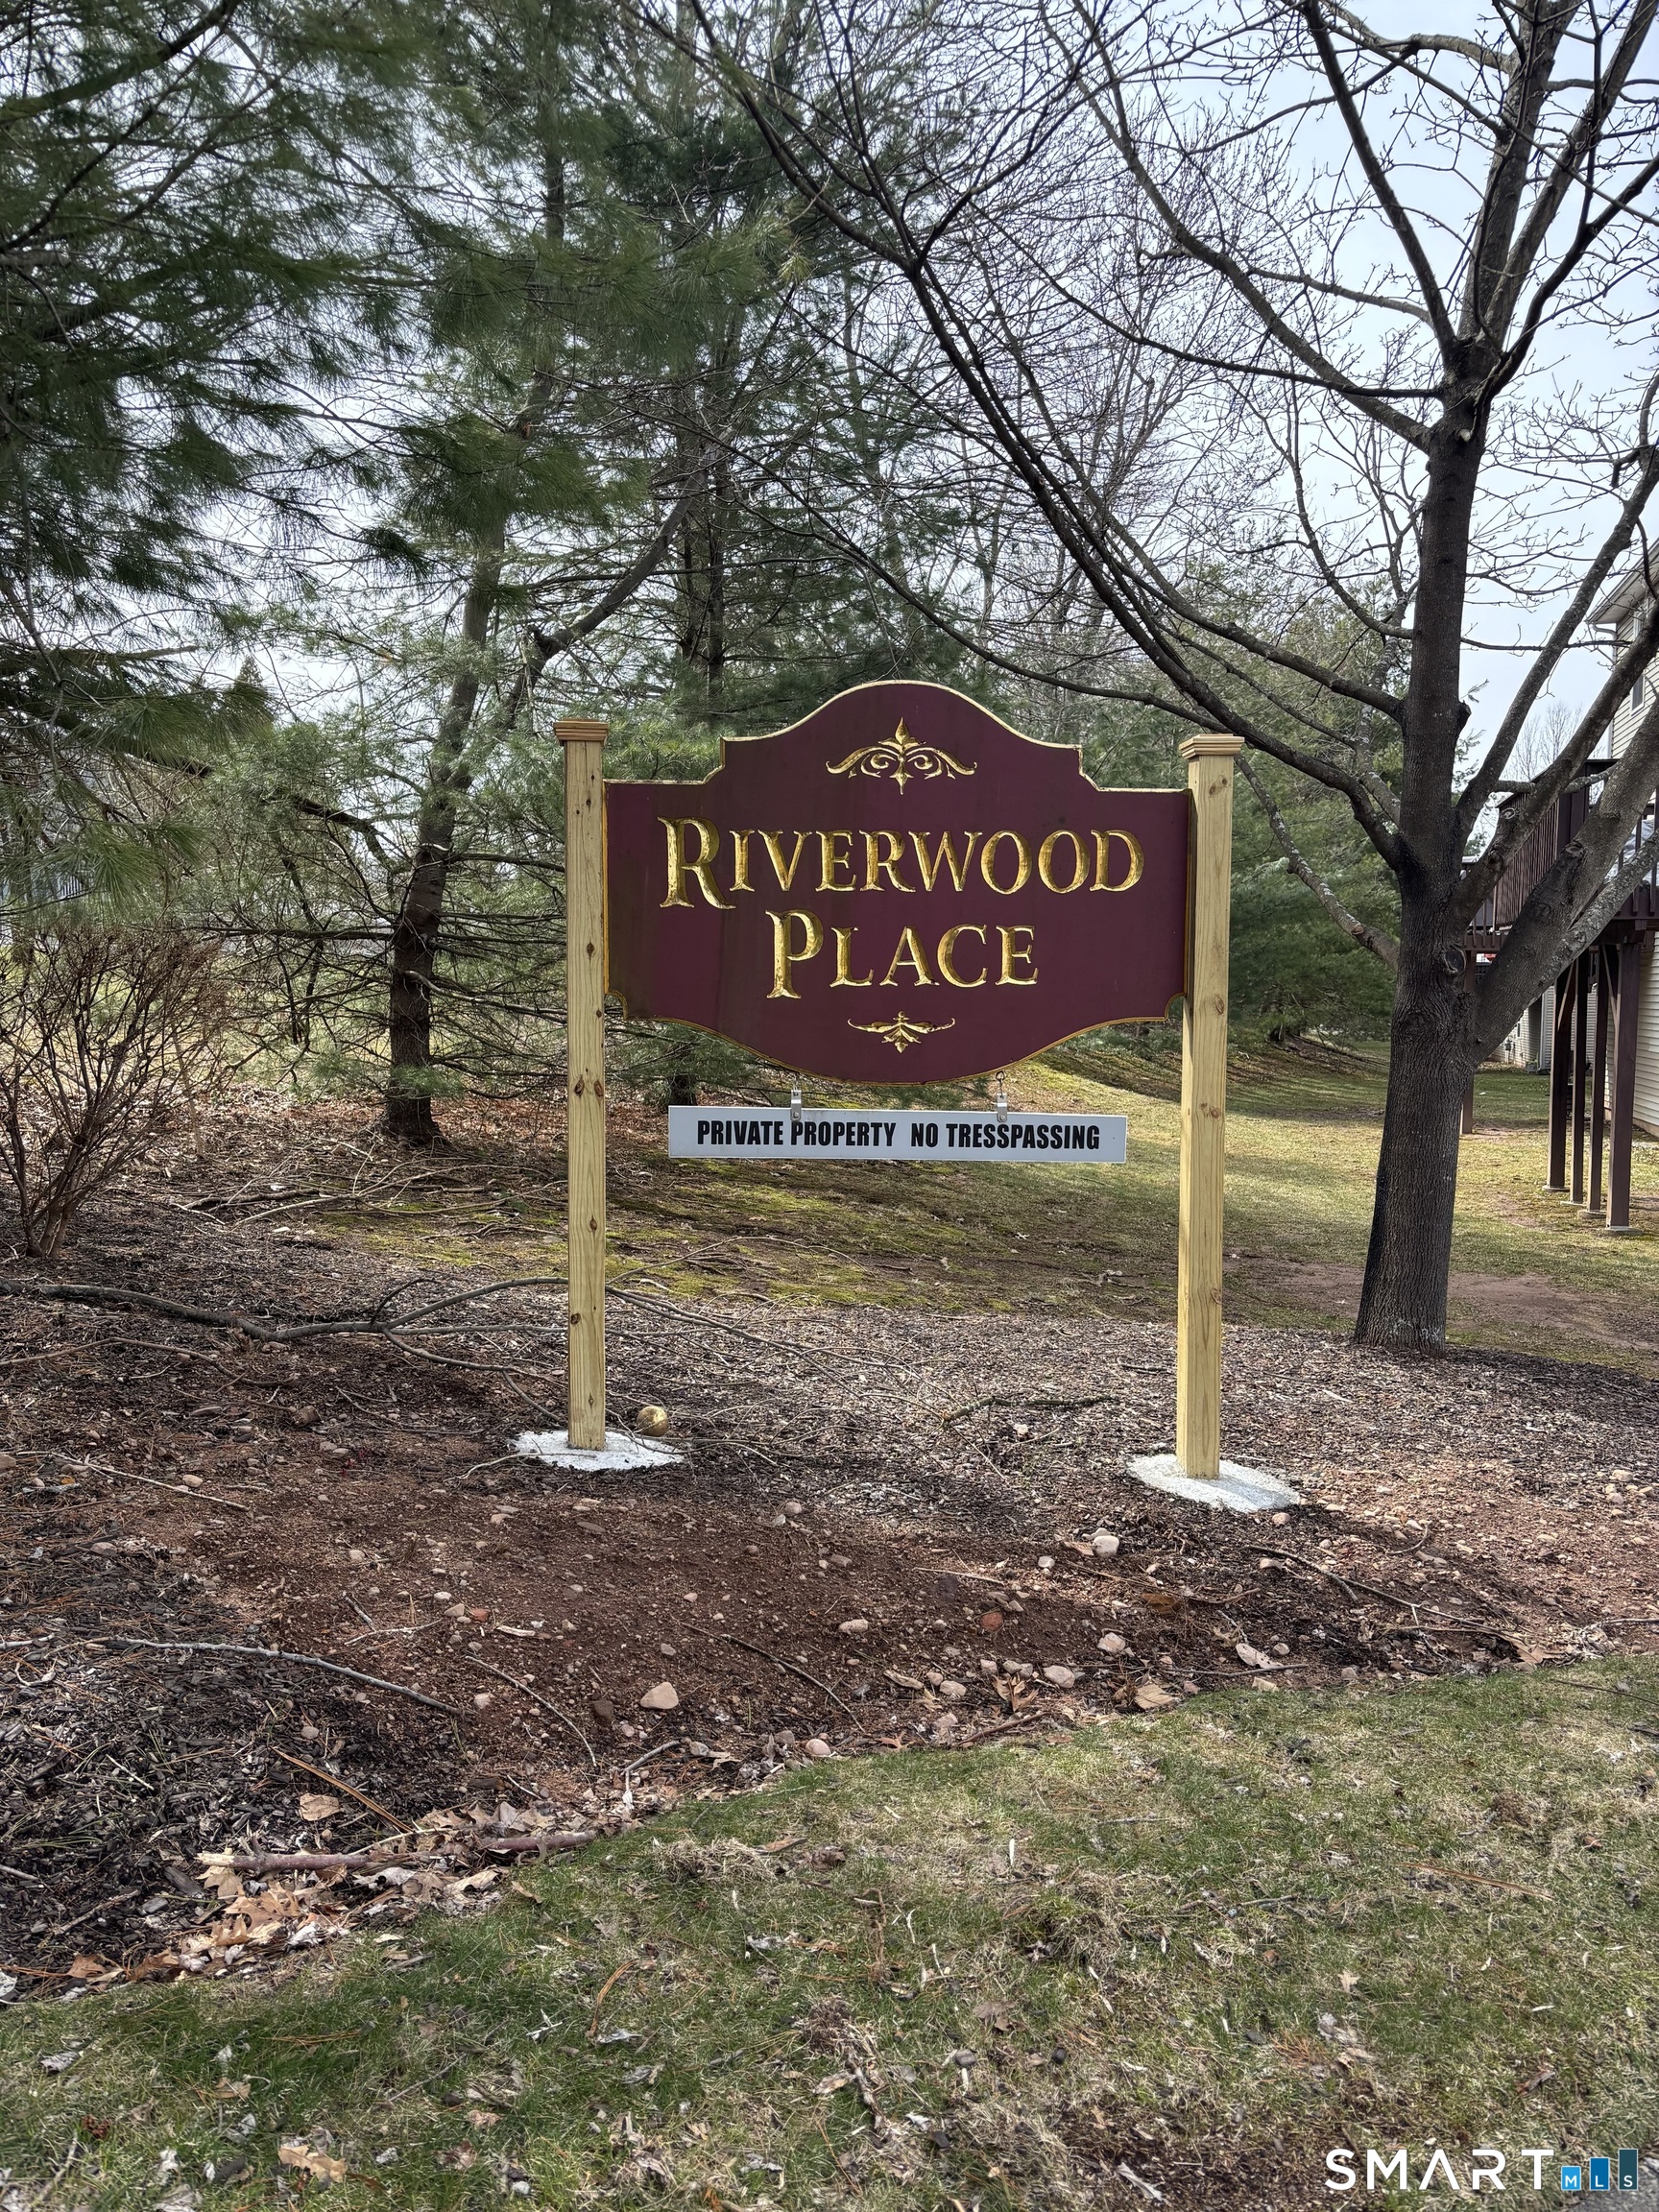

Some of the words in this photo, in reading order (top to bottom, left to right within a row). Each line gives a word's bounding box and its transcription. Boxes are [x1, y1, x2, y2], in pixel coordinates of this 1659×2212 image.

[658, 816, 1144, 909] RIVERWOOD
[765, 909, 1039, 999] PLACE
[697, 1119, 783, 1146] PRIVATE
[791, 1120, 897, 1147] PROPERTY
[911, 1122, 939, 1148] NO
[946, 1123, 1099, 1150] TRESSPASSING
